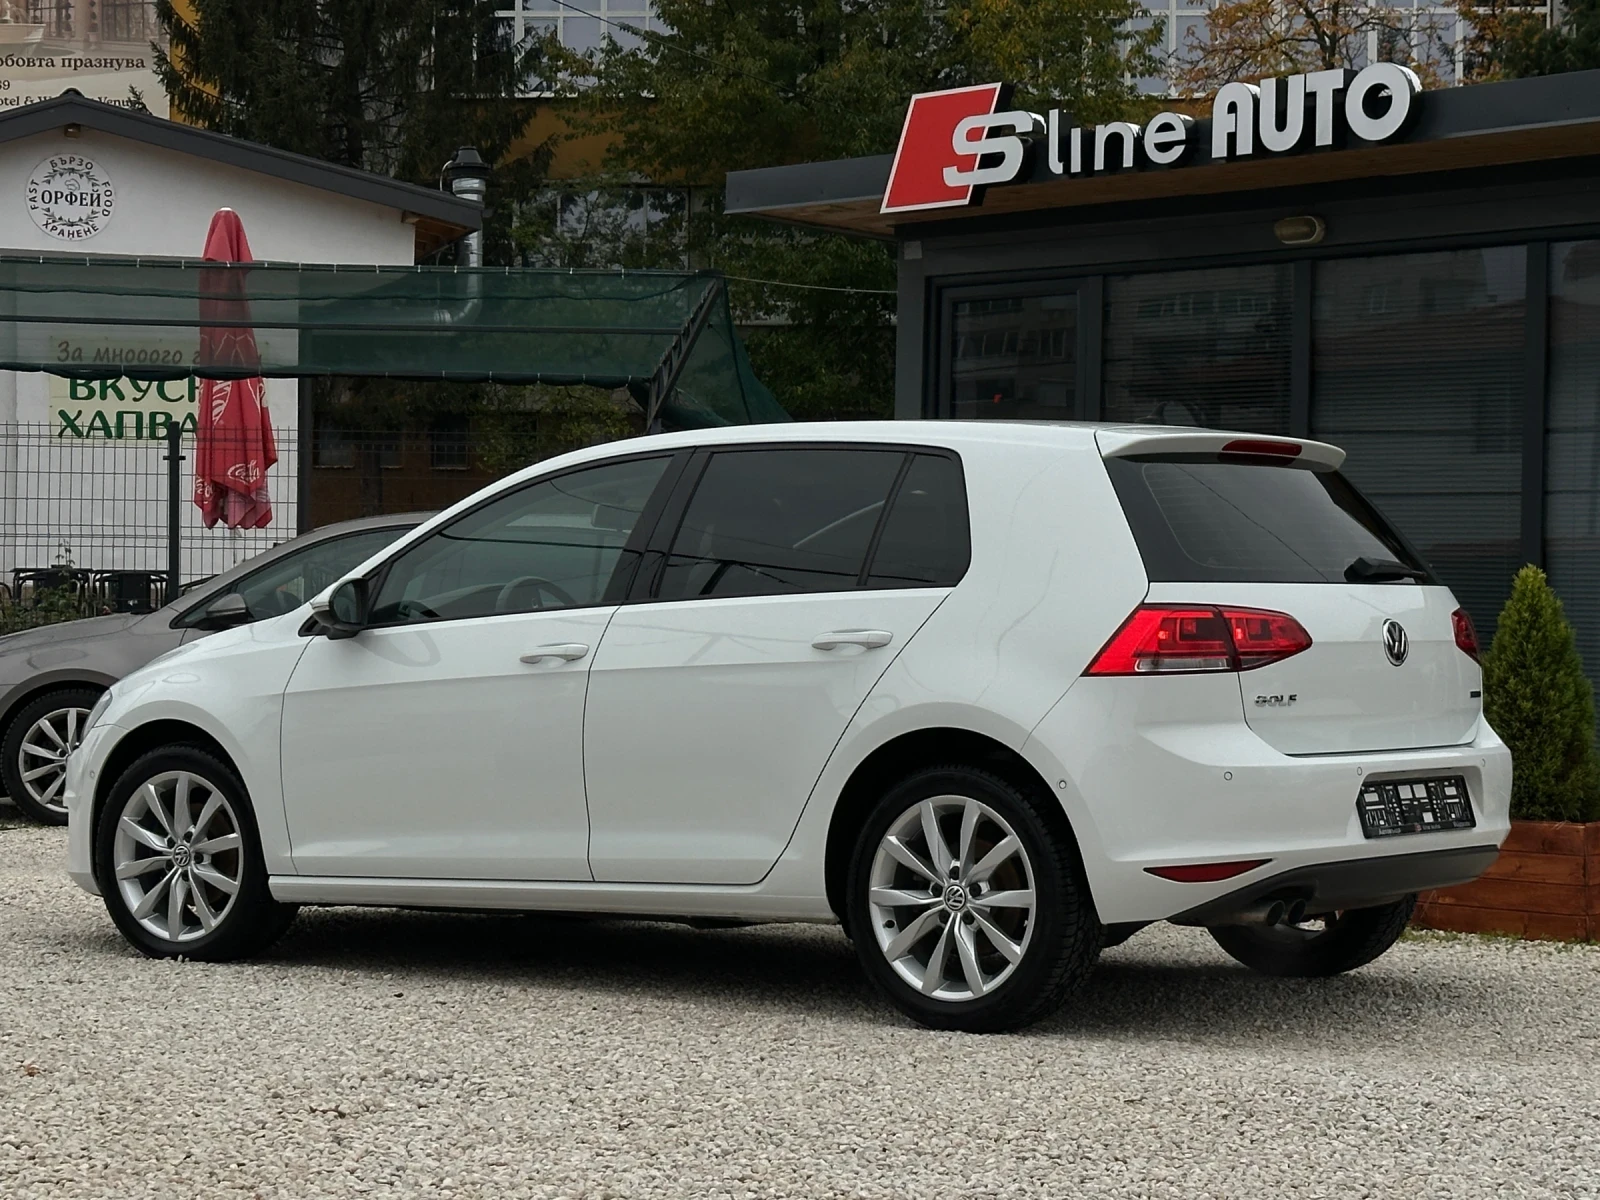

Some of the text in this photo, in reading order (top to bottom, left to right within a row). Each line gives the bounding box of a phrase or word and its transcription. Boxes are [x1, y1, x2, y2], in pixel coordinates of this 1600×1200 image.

[61, 56, 146, 71] празнува
[1212, 62, 1417, 158] AUTO
[49, 156, 94, 170] БЪРЗО
[41, 188, 102, 207] ОРФЕЙ
[101, 181, 113, 217] FOOD
[42, 219, 99, 238] ХРАНЕНЕ
[1254, 694, 1298, 708] GOLF
